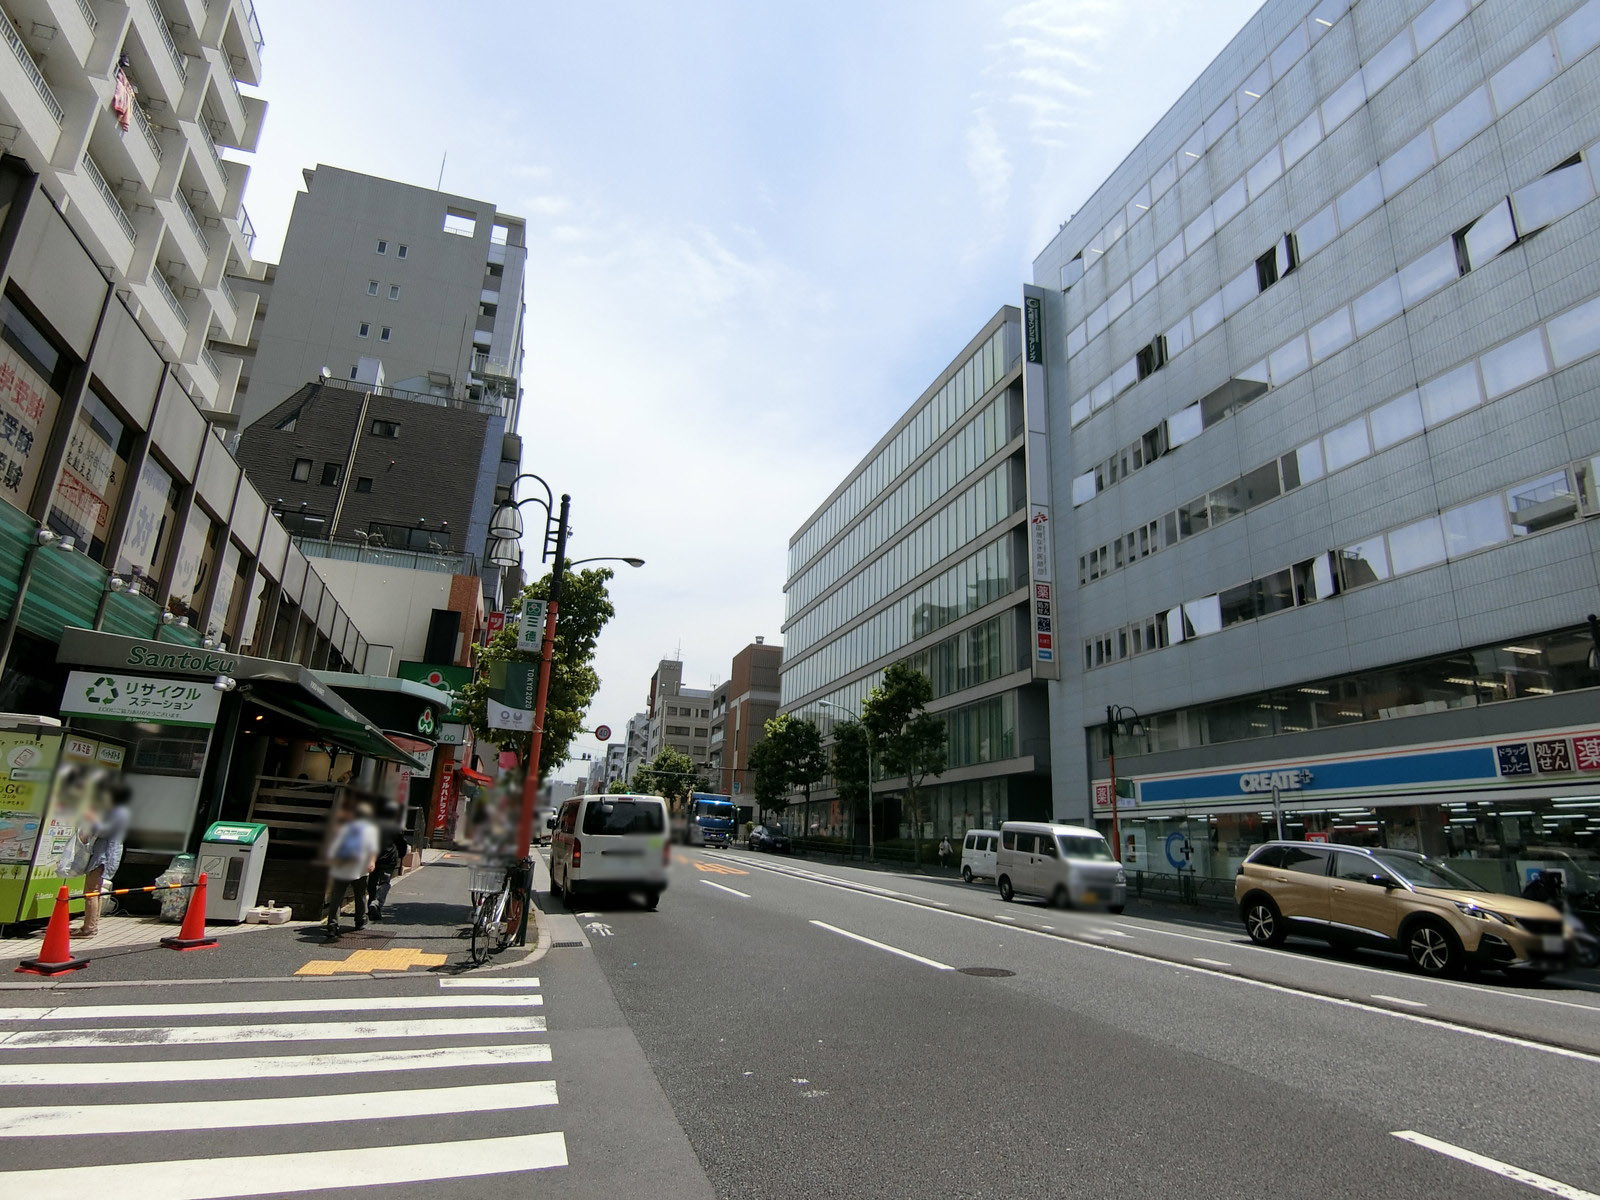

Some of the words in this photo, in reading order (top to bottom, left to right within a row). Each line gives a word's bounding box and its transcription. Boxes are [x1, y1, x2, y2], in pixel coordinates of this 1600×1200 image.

[0, 405, 34, 458] 受験
[524, 616, 539, 642] 三徳
[127, 646, 235, 674] Santoku
[526, 668, 535, 691] TOKYO
[125, 681, 201, 701] リサイクル
[128, 697, 193, 711] ステーション
[525, 692, 533, 709] 2020
[598, 728, 608, 738] 40
[1498, 745, 1528, 757] ドラッグ
[1535, 741, 1566, 758] 処方
[1576, 738, 1600, 768] 薬
[1501, 762, 1531, 773] コンビニ
[1538, 755, 1569, 770] せん
[437, 775, 451, 821] ツルハドラッグ
